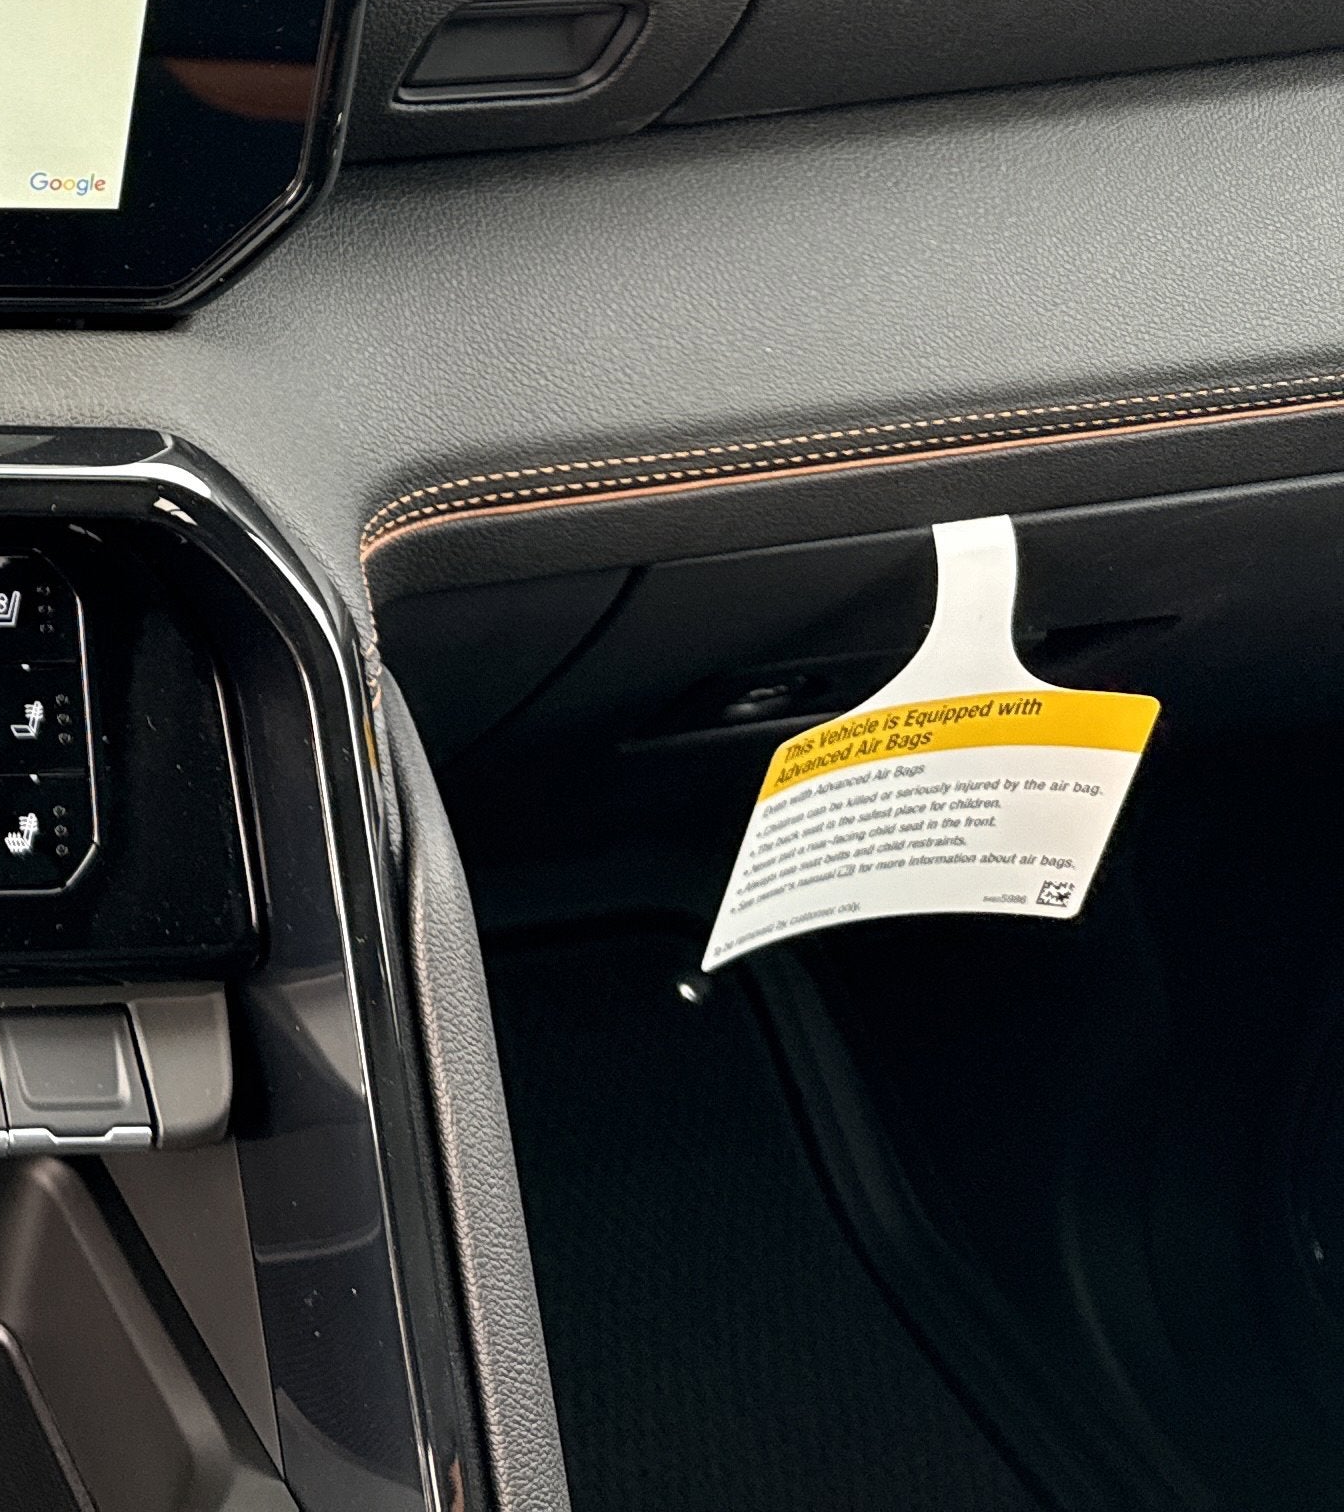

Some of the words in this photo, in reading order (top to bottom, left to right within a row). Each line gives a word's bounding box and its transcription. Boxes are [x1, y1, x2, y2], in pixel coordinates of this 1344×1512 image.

[29, 172, 107, 197] Google
[784, 737, 815, 763] This
[819, 717, 879, 748] Vehicle
[883, 714, 901, 731] is
[904, 700, 994, 728] Equipped
[998, 698, 1043, 716] with
[775, 743, 853, 786] Advanced
[855, 738, 882, 757] Air
[886, 732, 933, 750] Bags
[894, 764, 926, 778] Bags
[954, 779, 1001, 793] injured
[1004, 779, 1021, 792] by
[1024, 779, 1047, 790] the
[1050, 780, 1070, 792] air
[1073, 781, 1103, 797] bag.
[941, 817, 961, 829] the
[909, 852, 977, 867] information
[980, 852, 1017, 865] about
[1019, 854, 1037, 865] air
[1040, 855, 1077, 870] bags.
